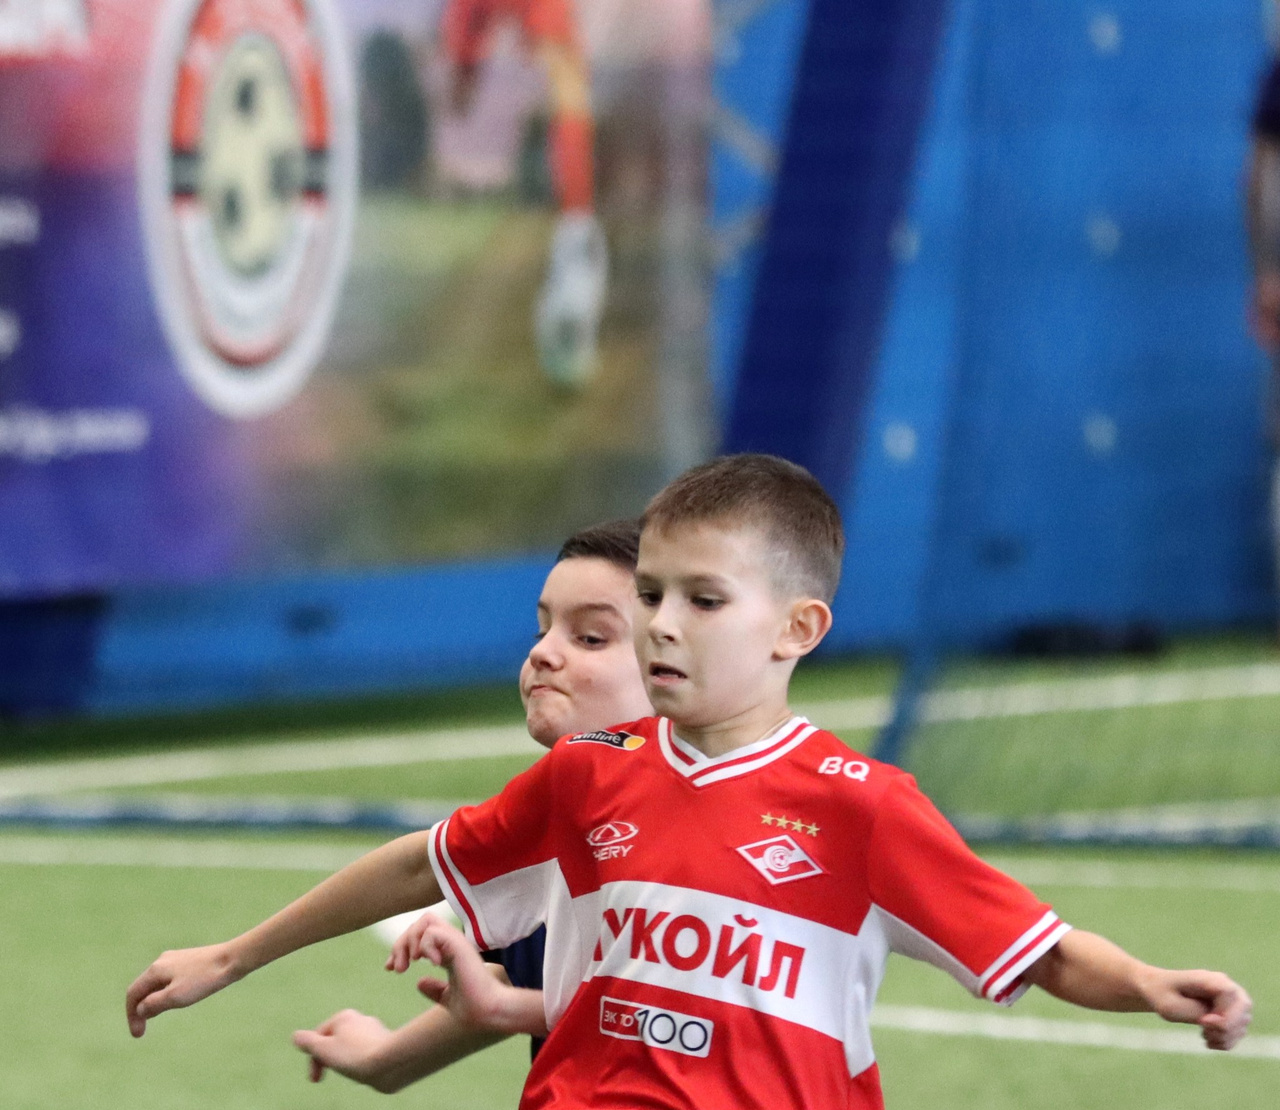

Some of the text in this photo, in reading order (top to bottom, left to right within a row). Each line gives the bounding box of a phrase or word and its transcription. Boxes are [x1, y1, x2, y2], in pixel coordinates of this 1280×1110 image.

[818, 757, 870, 782] BQ
[593, 908, 806, 999] УКОЙЛ
[638, 1009, 708, 1051] 100
